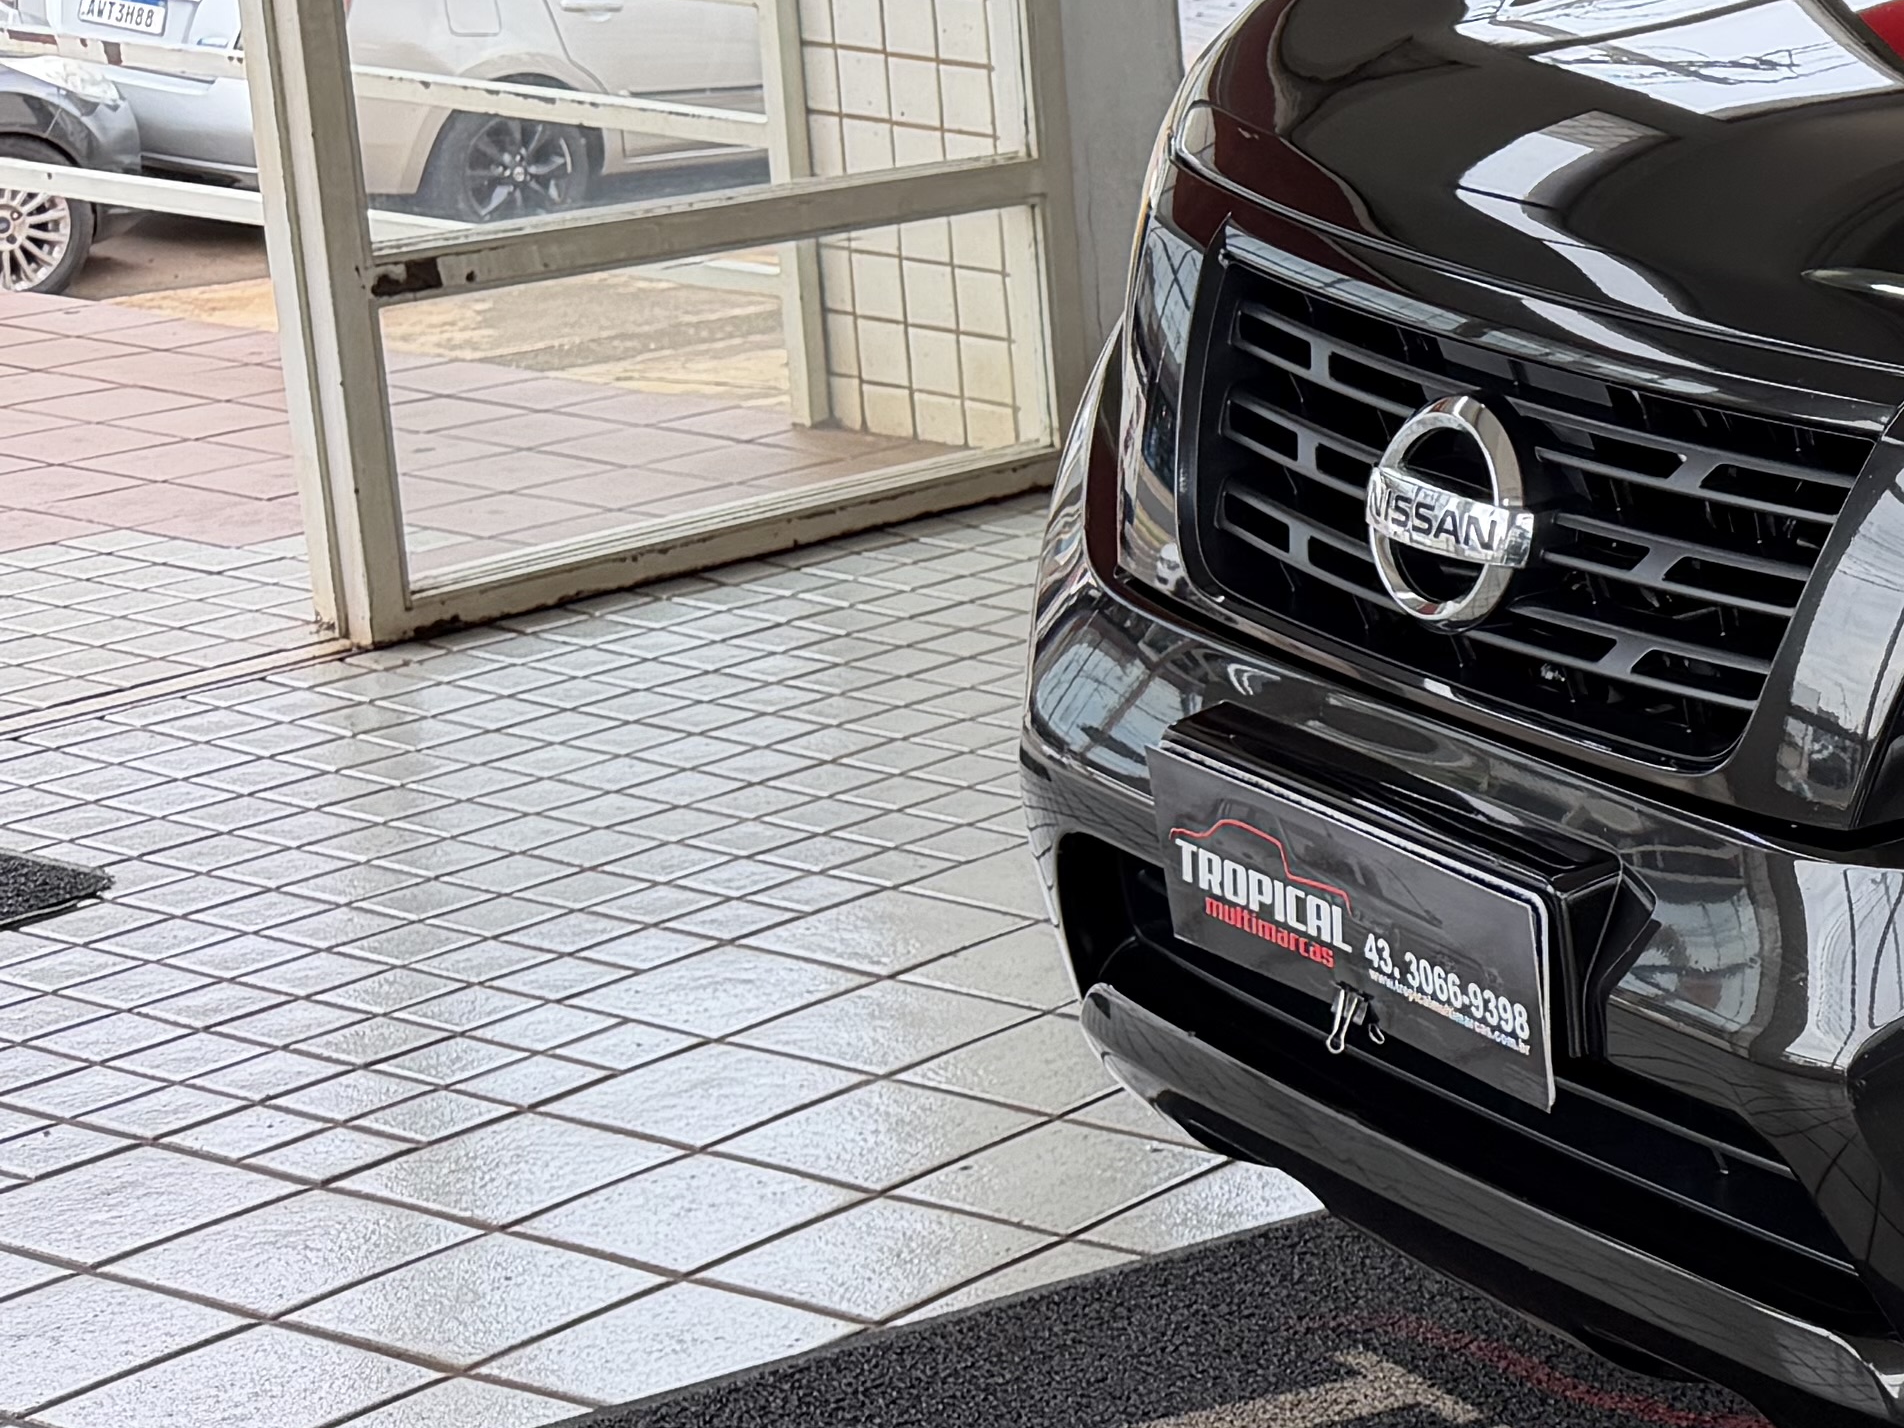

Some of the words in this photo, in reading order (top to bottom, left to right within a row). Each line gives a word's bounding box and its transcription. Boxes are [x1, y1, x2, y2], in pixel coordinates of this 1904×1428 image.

[1367, 474, 1498, 552] NISSAN
[1174, 837, 1353, 954] TROPICAL
[1204, 895, 1336, 969] multimarcas
[1404, 950, 1531, 1041] 3066-9398
